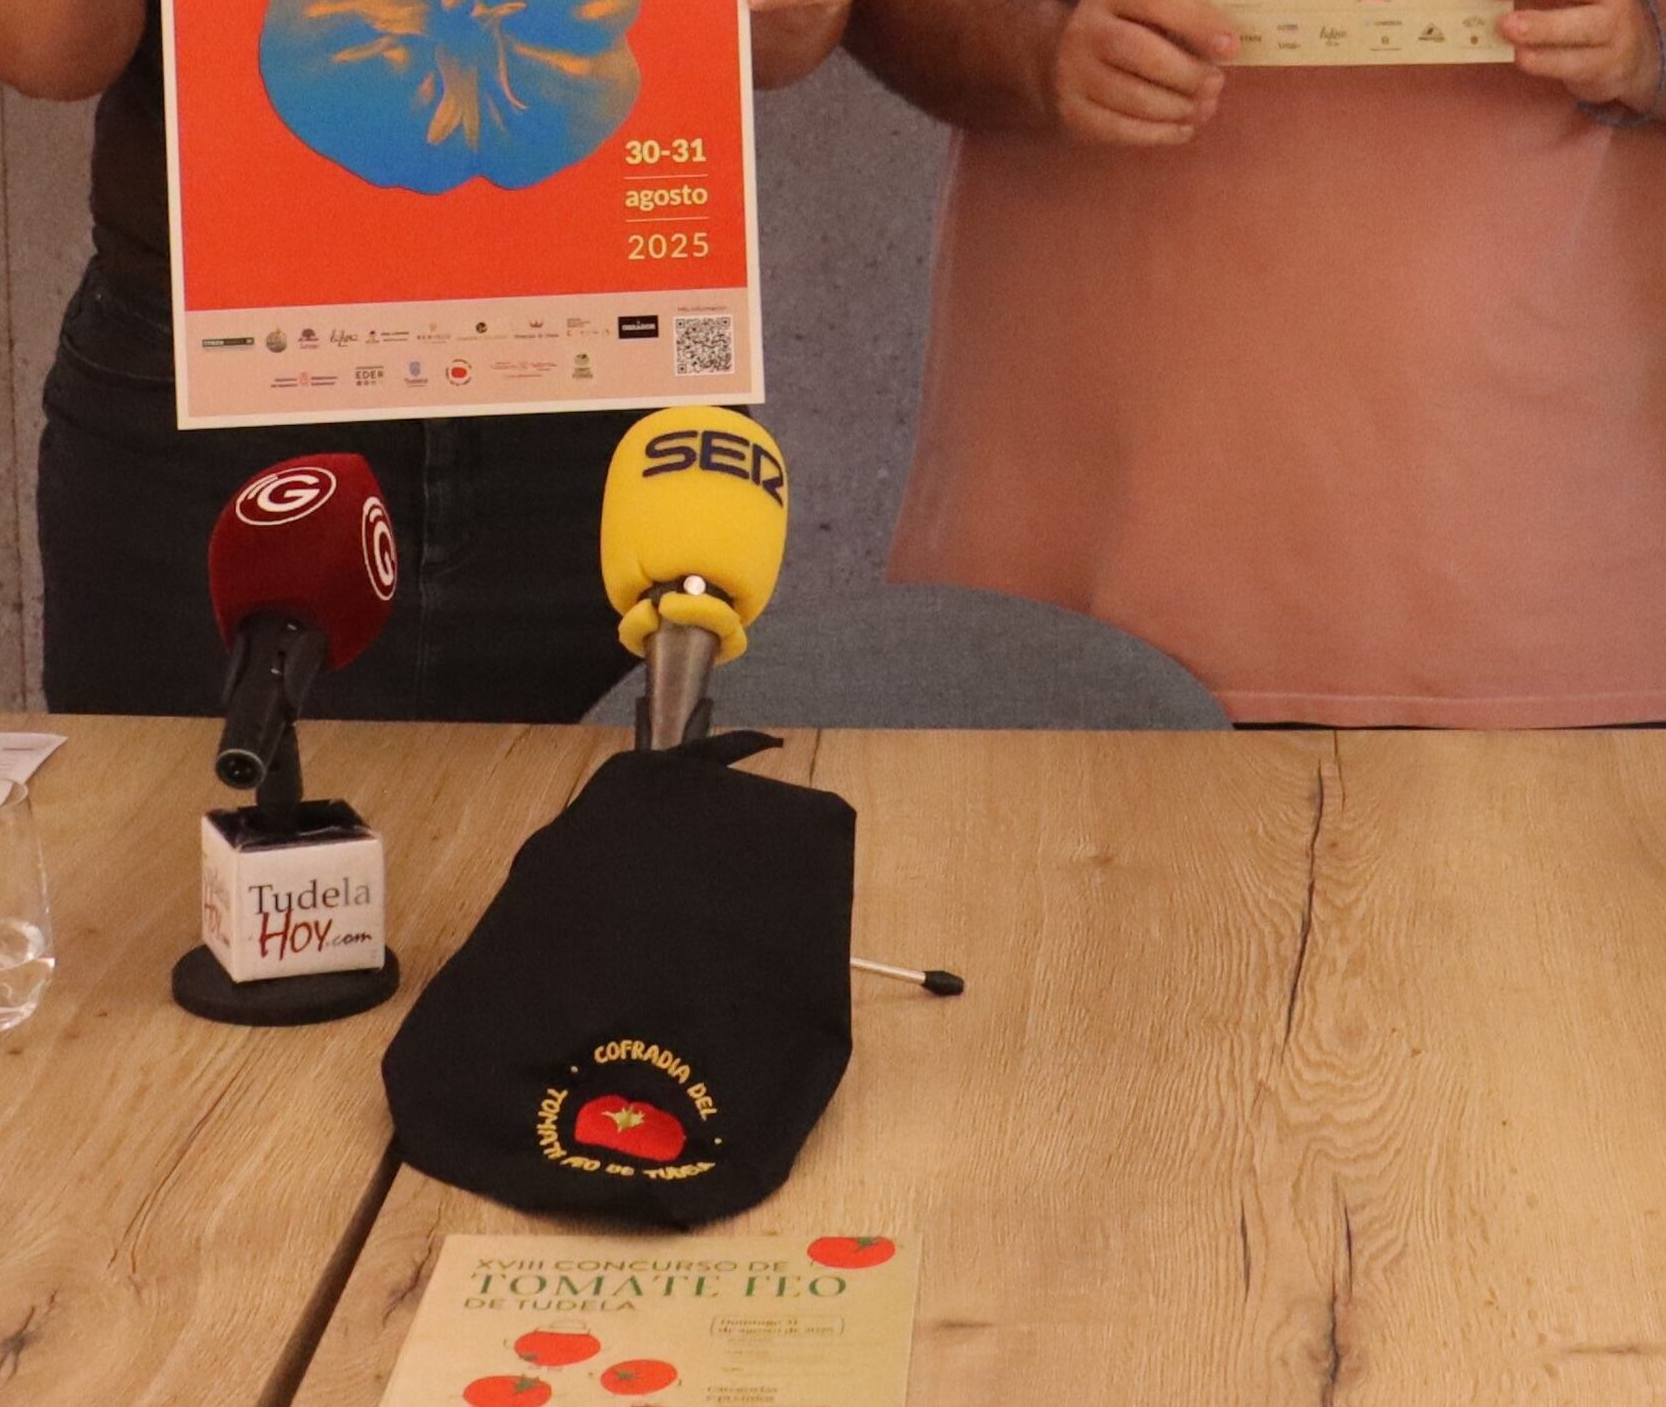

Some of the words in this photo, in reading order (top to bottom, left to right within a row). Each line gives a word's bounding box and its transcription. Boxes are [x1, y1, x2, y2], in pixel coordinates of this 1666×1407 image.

[625, 137, 707, 165] 30-31
[624, 184, 708, 212] agosto
[627, 231, 710, 260] 2025
[642, 430, 785, 508] SER
[249, 877, 371, 915] Tudela
[594, 1039, 691, 1084] COFRADIA
[687, 1082, 718, 1122] DEL
[477, 1259, 546, 1272] XVIII
[554, 1259, 739, 1273] CONCURSO
[747, 1260, 791, 1272] DE
[471, 1273, 722, 1299] TOMATE
[742, 1274, 848, 1299] FEO
[464, 1297, 507, 1311] DE
[517, 1298, 638, 1312] TUDELA
